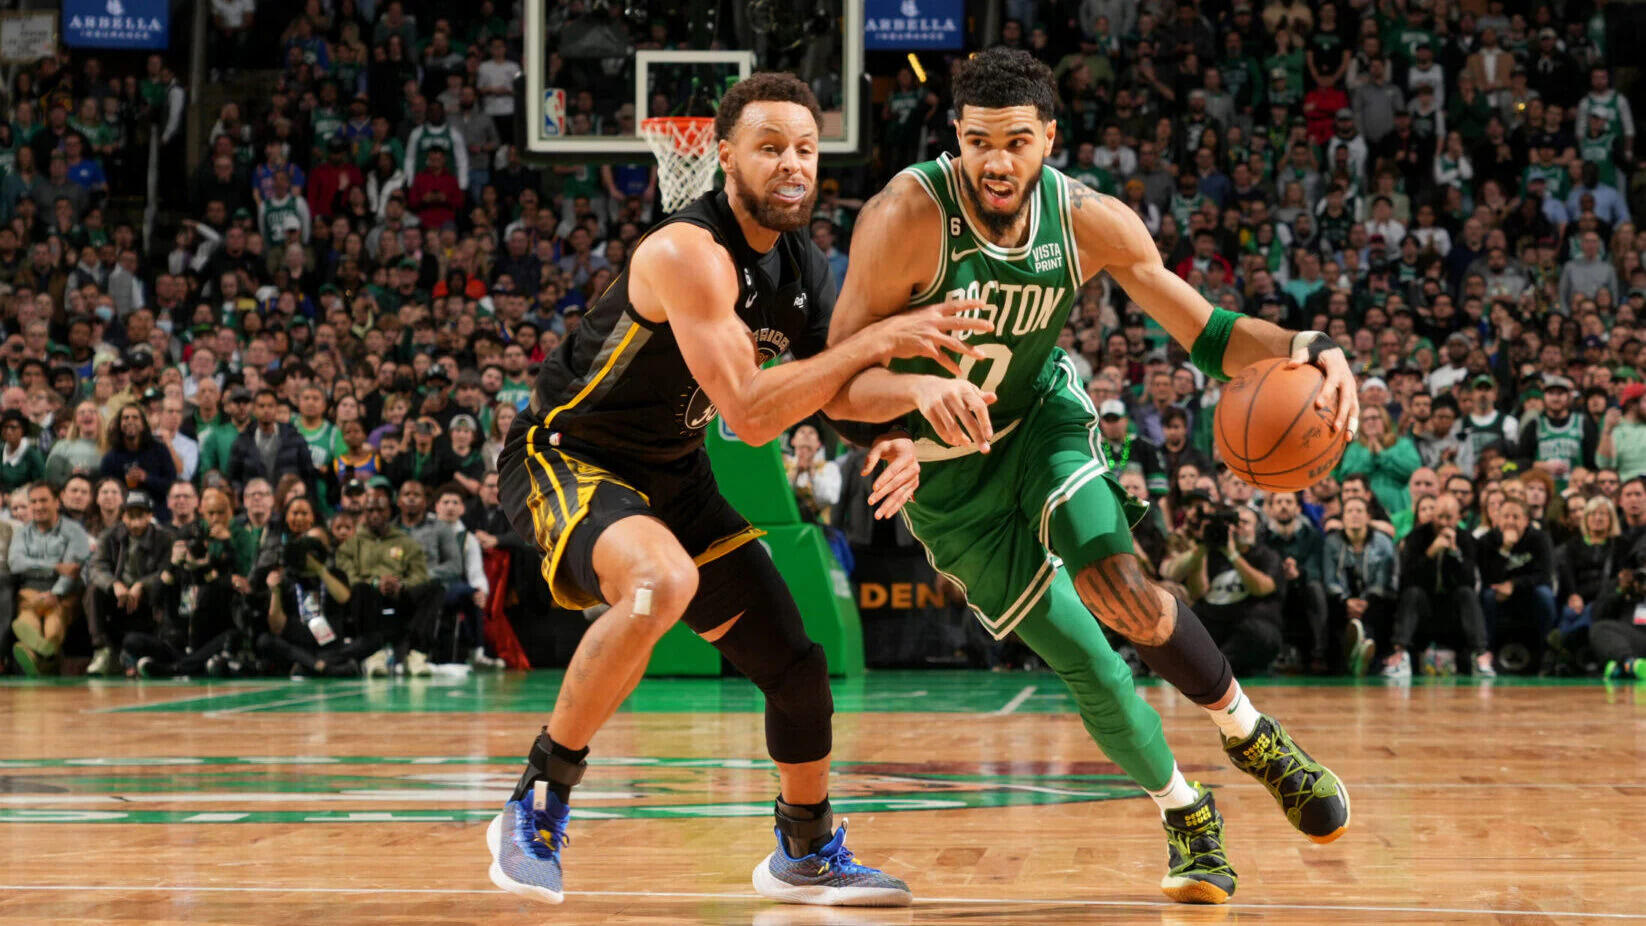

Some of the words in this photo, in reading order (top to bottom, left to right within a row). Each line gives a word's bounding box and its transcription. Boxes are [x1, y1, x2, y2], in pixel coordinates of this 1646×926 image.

[950, 217, 962, 236] 6
[1032, 243, 1062, 261] VISTA
[1034, 256, 1062, 273] PRINT
